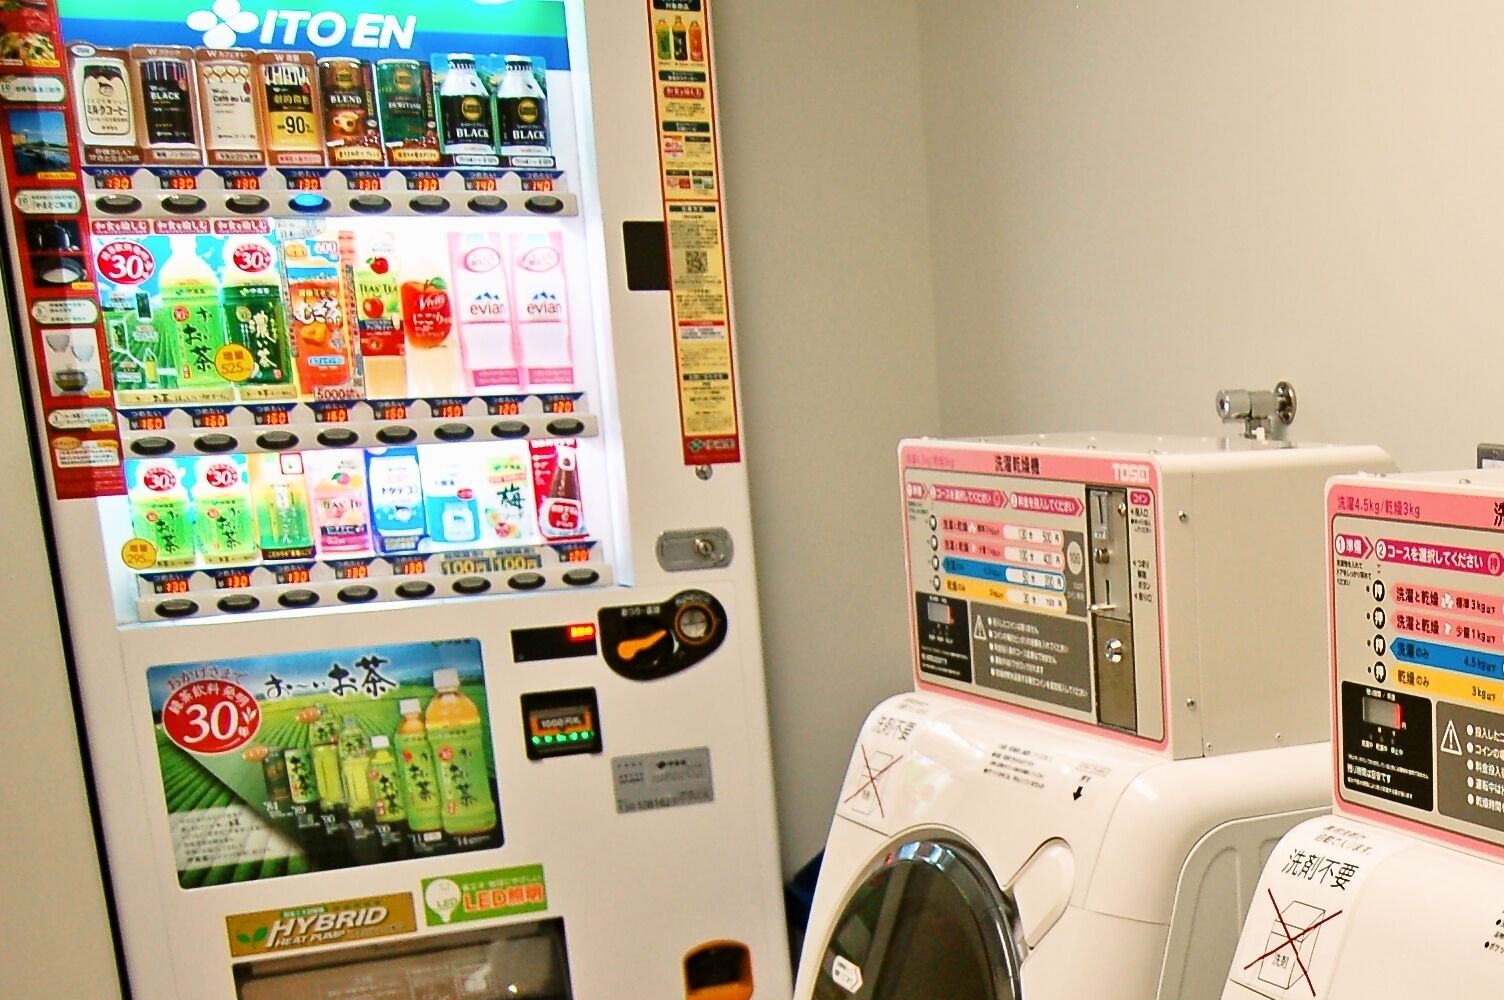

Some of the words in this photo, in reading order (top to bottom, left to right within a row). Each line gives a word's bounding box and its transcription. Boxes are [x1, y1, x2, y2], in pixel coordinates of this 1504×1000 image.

[259, 9, 347, 47] ITO
[351, 13, 417, 49] EN
[456, 128, 490, 139] BLACK
[512, 129, 545, 141] BLACK
[108, 254, 144, 279] 30
[1396, 586, 1439, 607] 洗濯と乾燥
[1396, 614, 1440, 635] 洗濯と乾燥
[183, 700, 239, 744] 30
[1281, 848, 1360, 890] 洗剤不要
[266, 906, 389, 948] HYBRID
